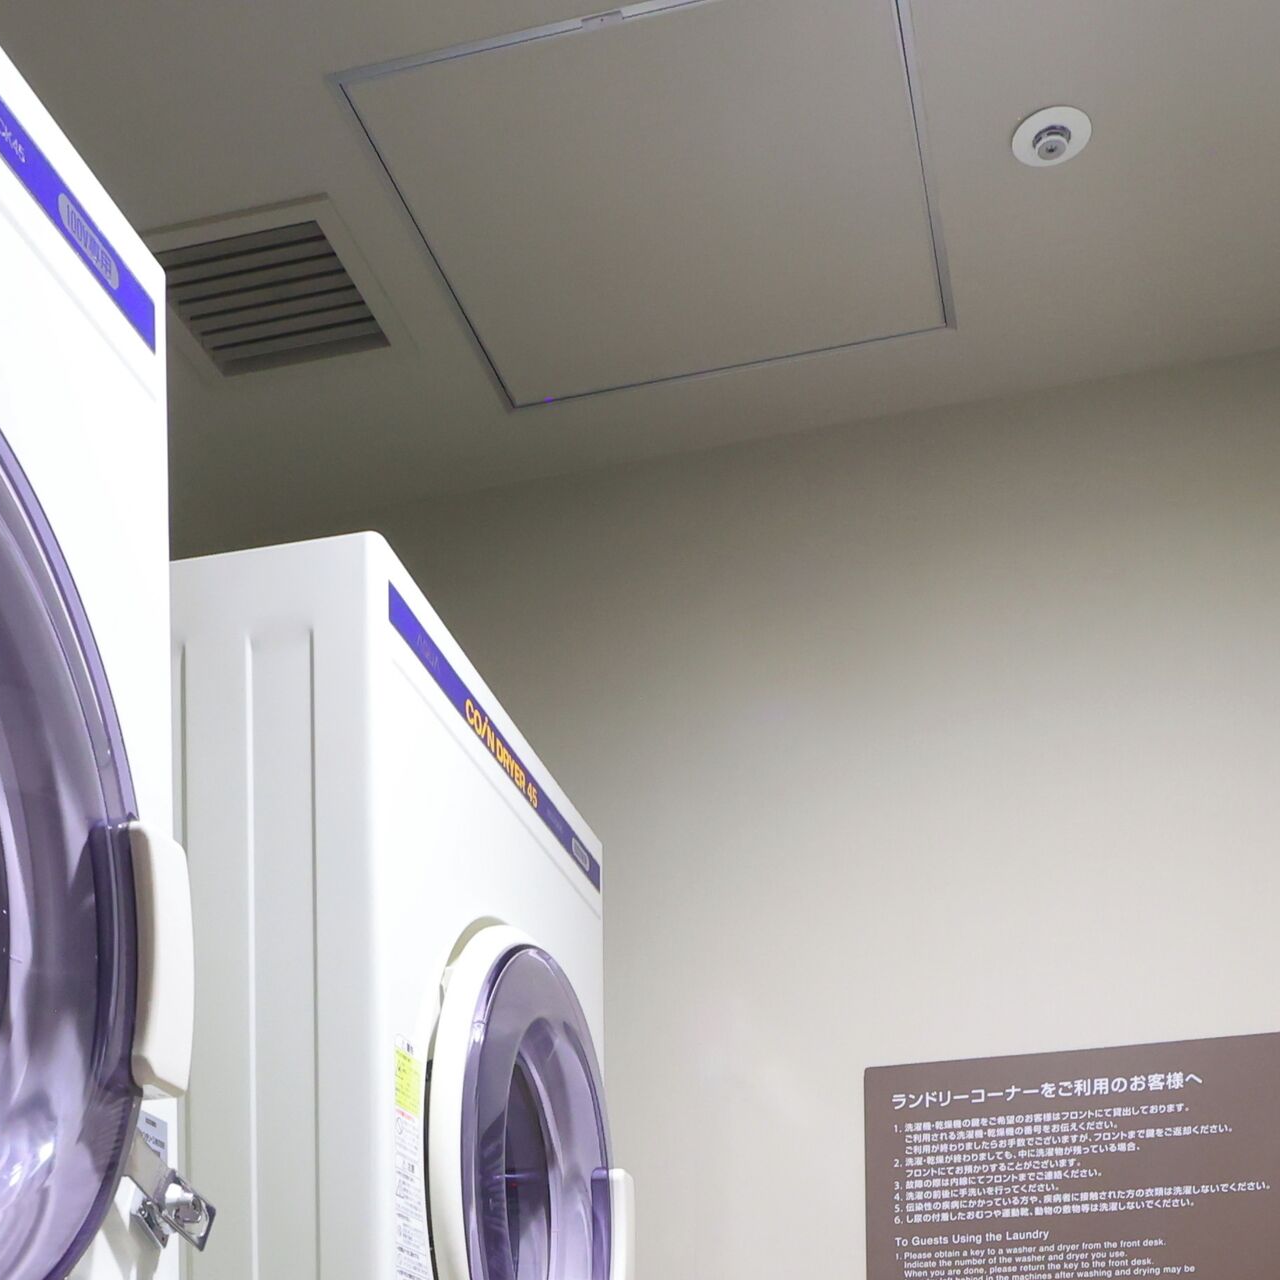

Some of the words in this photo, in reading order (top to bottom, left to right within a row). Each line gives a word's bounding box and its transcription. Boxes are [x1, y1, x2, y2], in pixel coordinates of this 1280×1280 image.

[465, 698, 495, 753] COIN
[496, 739, 526, 793] DRYER
[527, 782, 538, 808] 45
[892, 1069, 1202, 1111] ランドリーコーナーをご利用のお客様へ
[895, 1236, 908, 1246] To
[911, 1234, 948, 1246] Guests
[952, 1232, 981, 1245] Using
[985, 1231, 1001, 1241] the
[1006, 1228, 1049, 1242] Laundry
[904, 1250, 931, 1259] Please
[934, 1249, 959, 1258] obtain
[970, 1248, 984, 1257] key
[987, 1247, 995, 1255] to
[1005, 1245, 1036, 1254] washer
[1039, 1244, 1054, 1252] and
[1057, 1242, 1079, 1252] dryer
[1082, 1241, 1101, 1250] from
[1104, 1240, 1117, 1248] the
[1120, 1239, 1139, 1247] front
[904, 1259, 936, 1268] Indicate
[954, 1257, 985, 1265] number
[988, 1256, 996, 1264] of
[999, 1255, 1012, 1263] the
[1015, 1253, 1044, 1262] washer
[1048, 1252, 1063, 1260] and
[1066, 1251, 1088, 1261] dryer
[1091, 1251, 1106, 1259] you
[904, 1269, 927, 1277] When
[989, 1265, 1016, 1274] please
[1020, 1263, 1044, 1271] return
[1047, 1262, 1060, 1270] the
[1063, 1261, 1078, 1270] key
[1092, 1260, 1105, 1268] the
[1108, 1258, 1128, 1267] front
